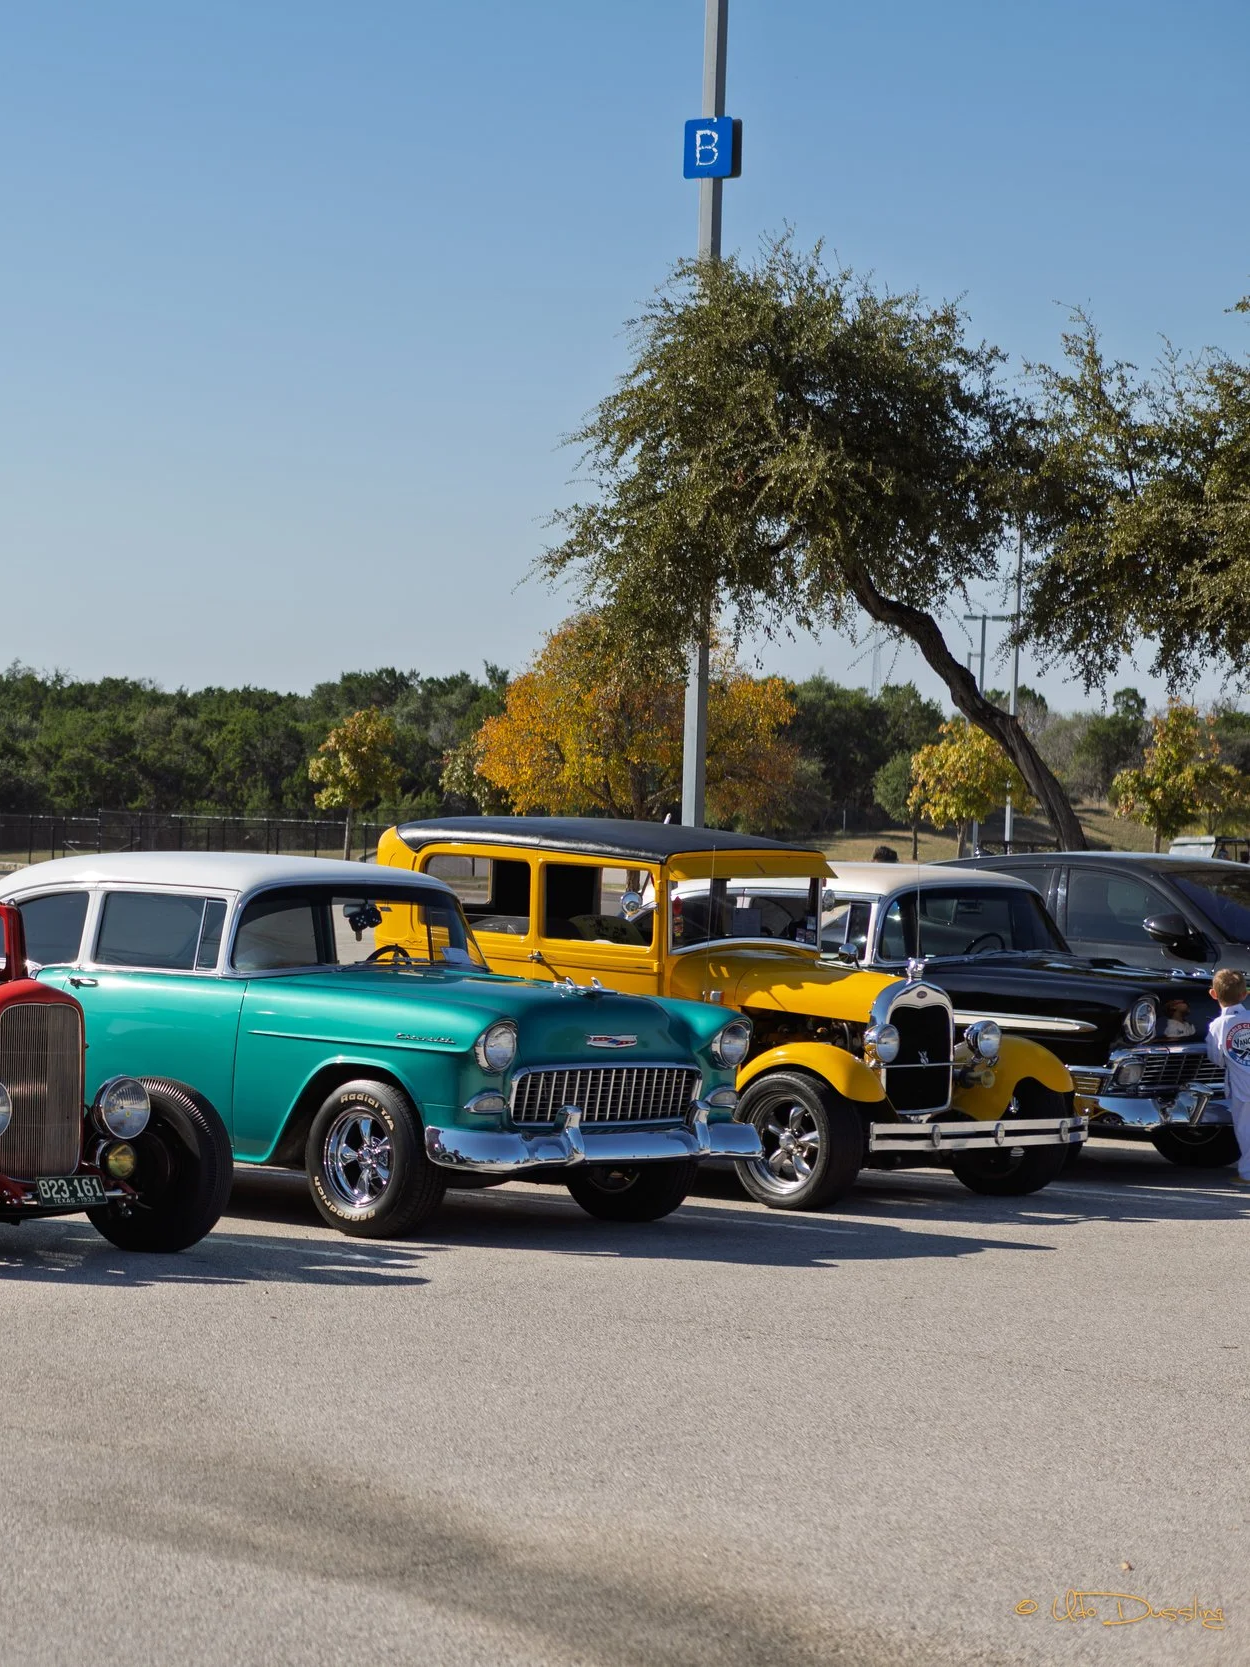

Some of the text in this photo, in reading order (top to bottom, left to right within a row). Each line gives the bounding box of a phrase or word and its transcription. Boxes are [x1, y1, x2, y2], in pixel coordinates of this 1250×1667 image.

[696, 130, 718, 166] B
[340, 1092, 395, 1131] Radial T/A
[314, 1176, 375, 1221] BFGoodrich
